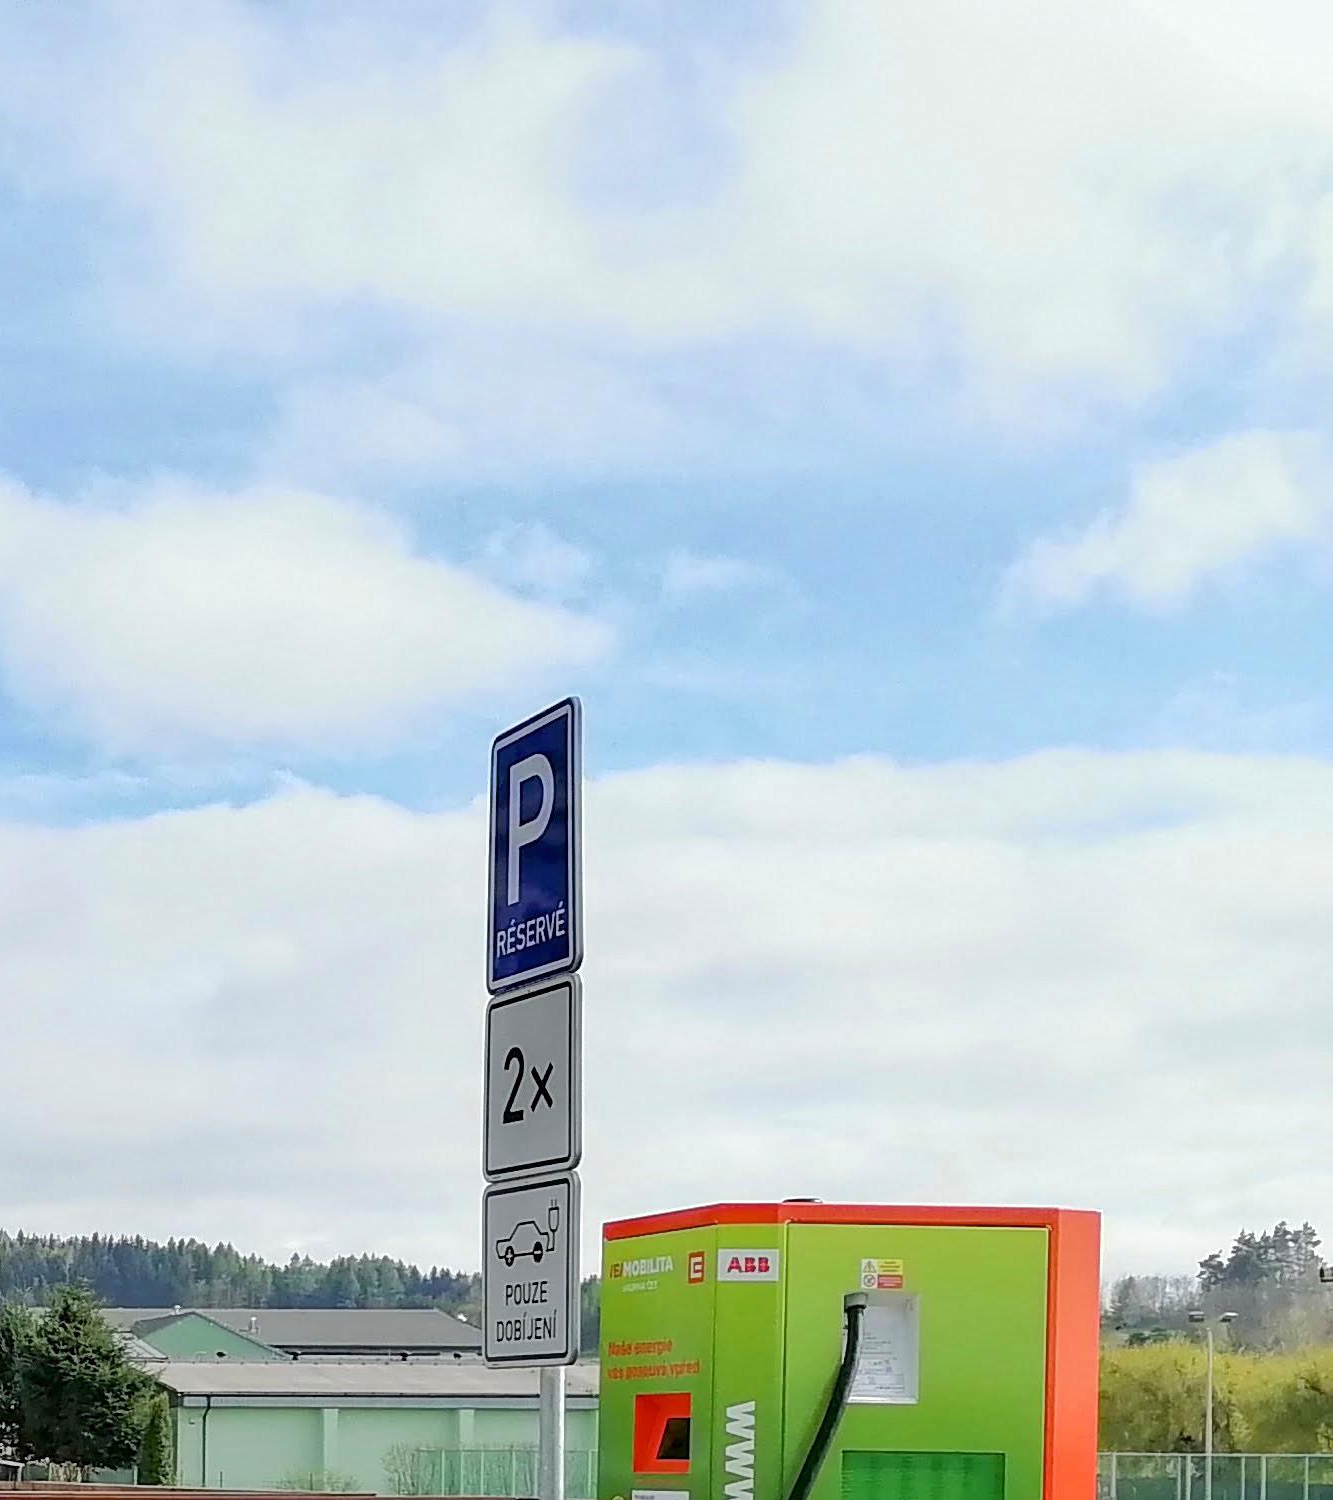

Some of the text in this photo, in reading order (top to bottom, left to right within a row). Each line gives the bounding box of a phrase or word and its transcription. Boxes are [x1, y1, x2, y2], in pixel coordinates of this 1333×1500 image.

[507, 753, 555, 906] P
[496, 900, 566, 958] RÉSERVÉ
[502, 1046, 554, 1125] 2x
[727, 1256, 771, 1274] ABB
[505, 1280, 548, 1306] POUZE
[496, 1308, 557, 1343] DOBÍJENÍ
